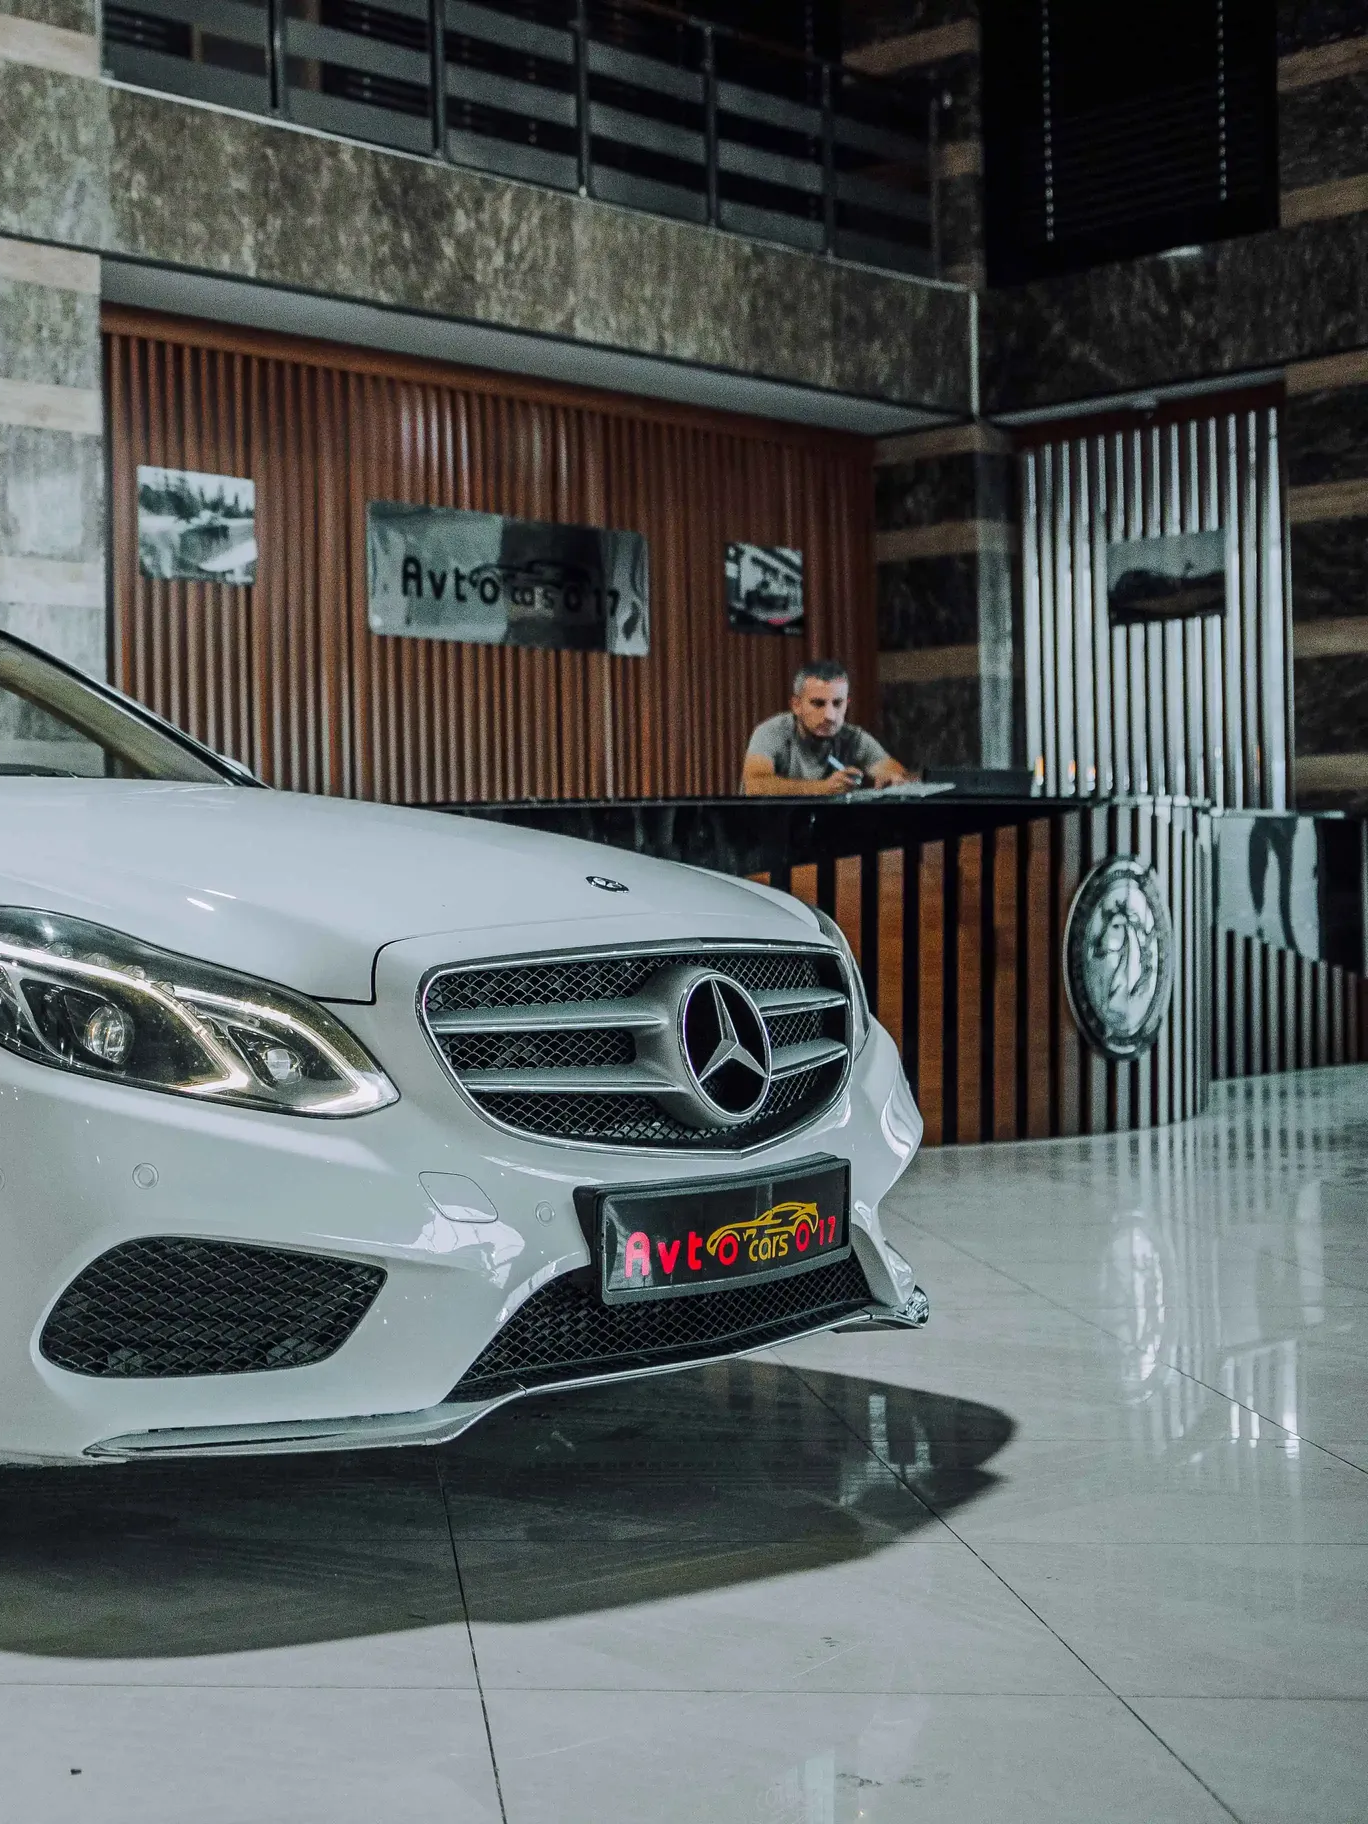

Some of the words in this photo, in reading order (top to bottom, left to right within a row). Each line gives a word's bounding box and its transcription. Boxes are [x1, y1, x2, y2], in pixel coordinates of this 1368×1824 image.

[401, 556, 500, 604] Avto
[511, 586, 555, 611] cas
[625, 1231, 739, 1279] Avto
[748, 1232, 789, 1262] cars
[795, 1215, 837, 1252] 017
